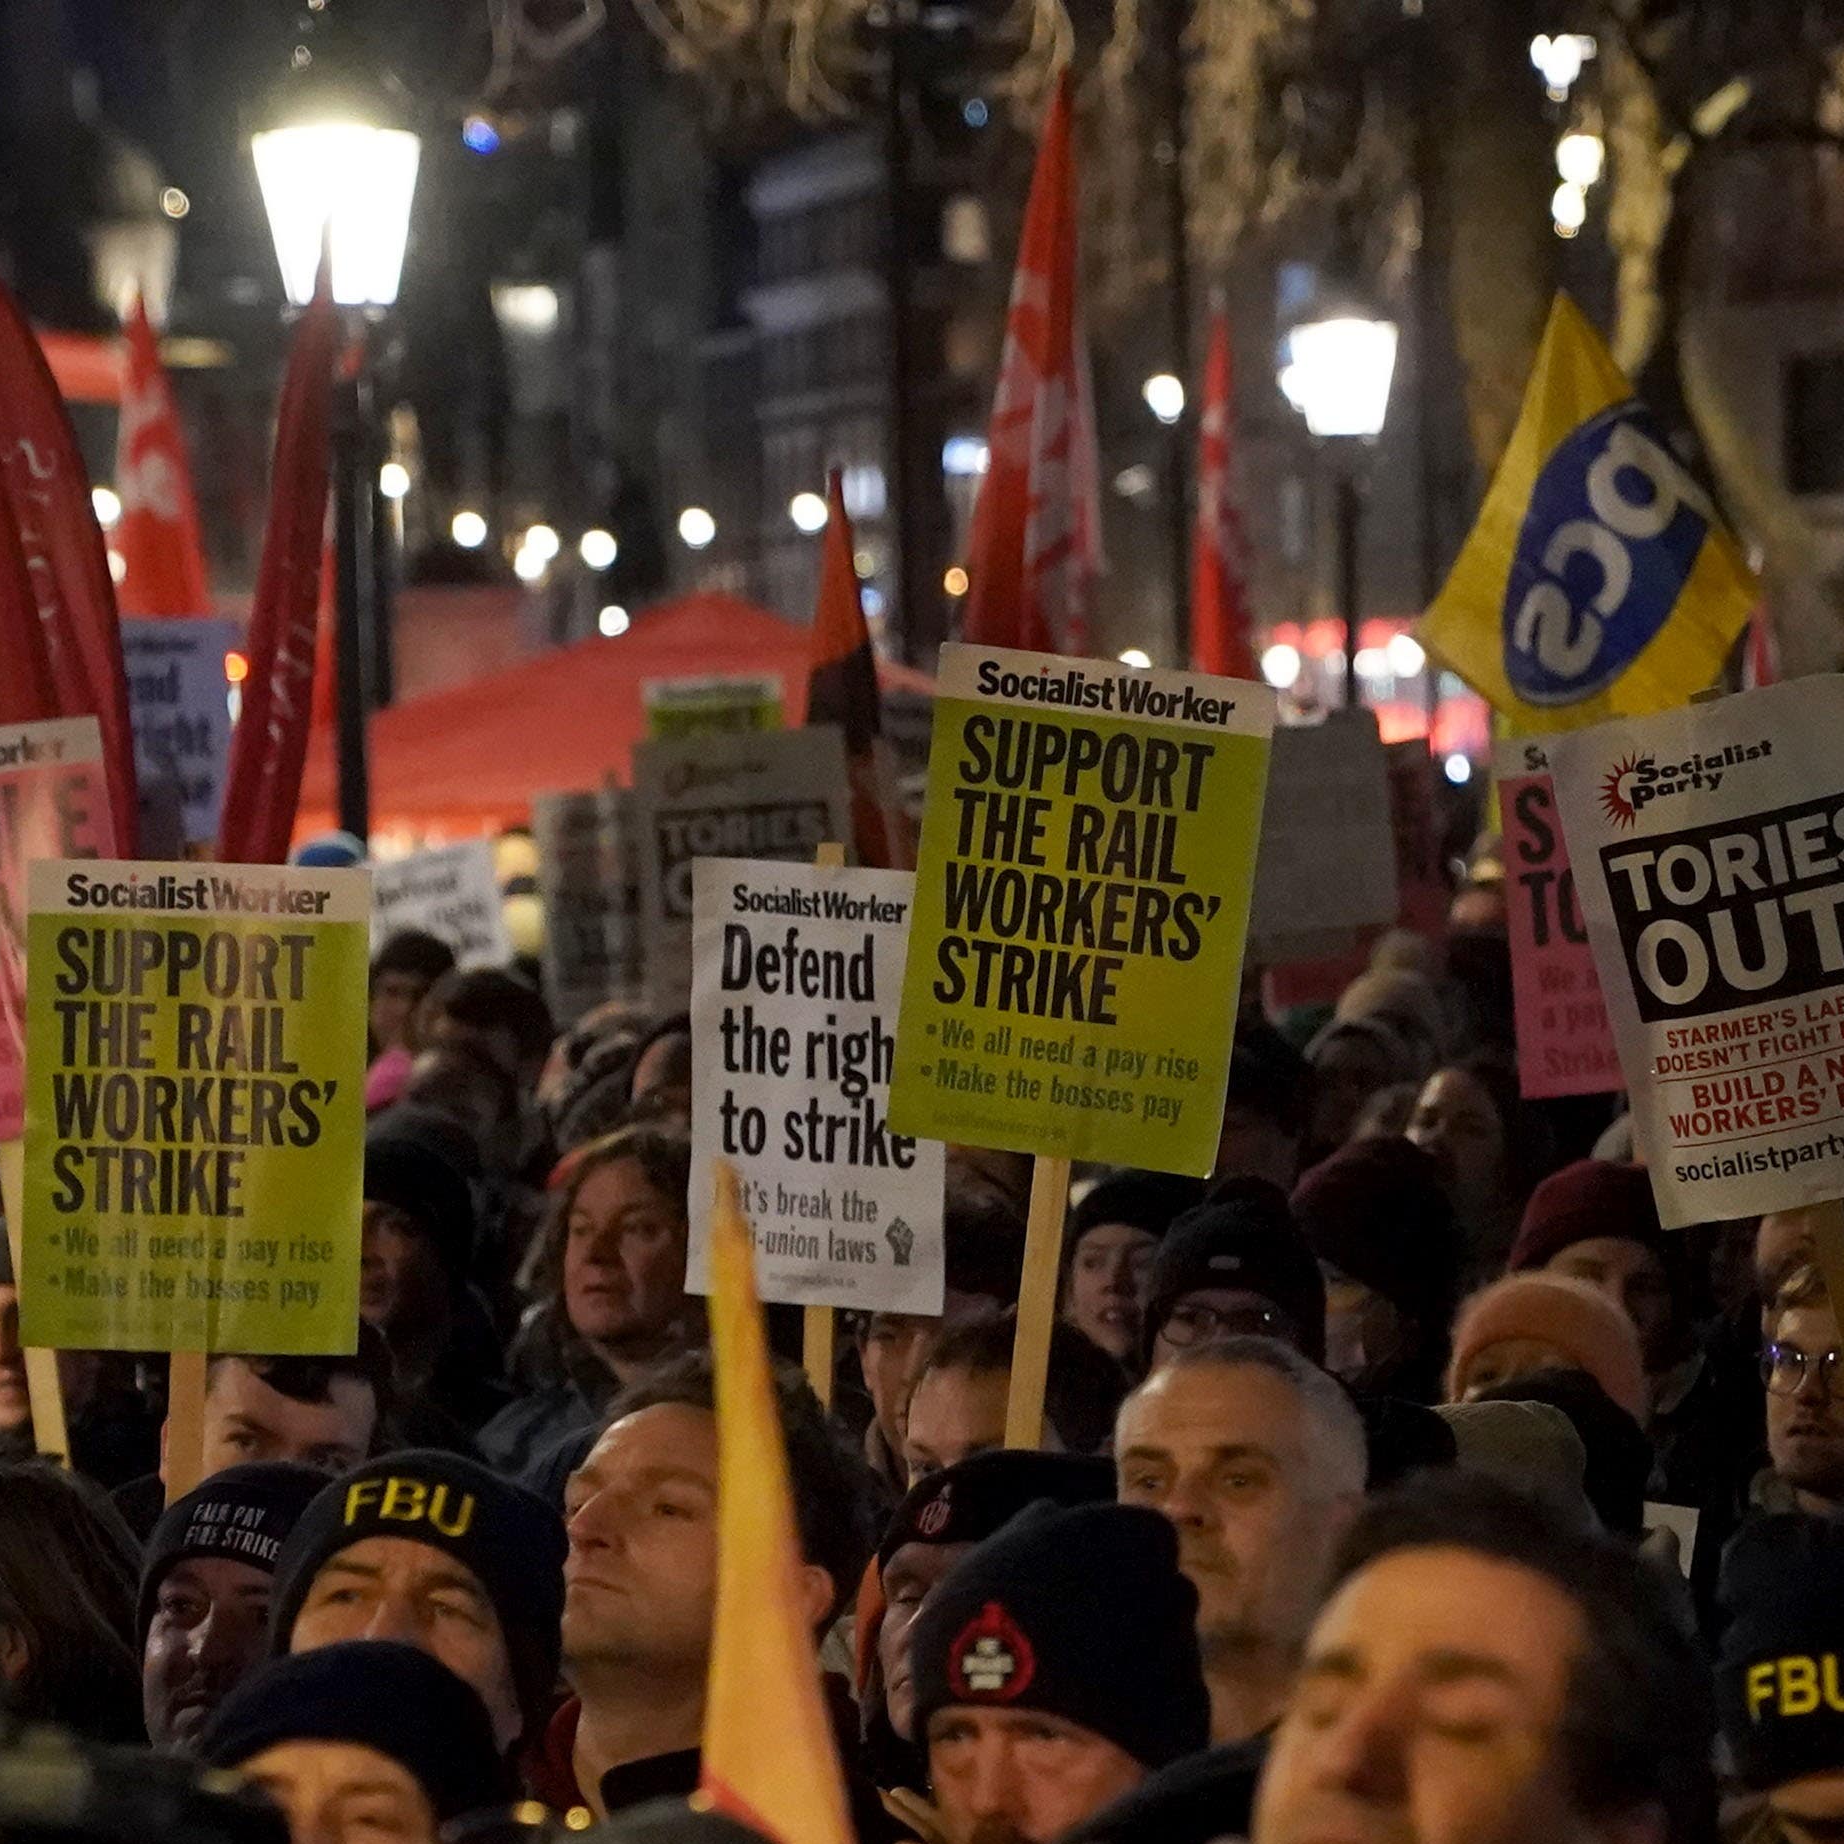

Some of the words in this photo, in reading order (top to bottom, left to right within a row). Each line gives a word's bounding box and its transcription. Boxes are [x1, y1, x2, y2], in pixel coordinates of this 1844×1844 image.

[978, 661, 1115, 712] Socialist
[1118, 677, 1235, 724] Worker
[960, 715, 1216, 812] SUPPORT
[1635, 739, 1772, 784] Socialist
[954, 788, 1052, 866] THE
[1066, 804, 1185, 885] RAIL
[67, 873, 208, 911] Socialist
[211, 877, 330, 915] Worker
[733, 884, 822, 917] Socialist
[824, 892, 907, 924] Worker
[56, 927, 315, 1001] SUPPORT
[720, 924, 874, 1002] Defend
[933, 936, 1124, 1026] STRIKE
[54, 1000, 156, 1070] THE
[177, 1004, 299, 1074] RAIL
[719, 1007, 791, 1077] the
[806, 1014, 894, 1099] righ
[940, 1018, 975, 1049] We
[984, 1023, 1011, 1057] all
[1019, 1029, 1075, 1066] need
[1084, 1043, 1097, 1066] a
[1106, 1046, 1146, 1080] pay
[1157, 1047, 1199, 1082] rise
[1656, 1044, 1751, 1075] DOESN'T
[1758, 1024, 1832, 1059] FIGHT
[1667, 1009, 1797, 1048] STARMER'S
[935, 1059, 996, 1096] Make
[1006, 1066, 1041, 1102] the
[1051, 1073, 1135, 1113] bosses
[1142, 1091, 1183, 1126] pay
[1670, 1089, 1827, 1138] WORKERS'
[1692, 1071, 1785, 1108] BUILD
[1797, 1064, 1819, 1089] A
[719, 1090, 766, 1155] to
[784, 1098, 916, 1169] strike
[53, 1147, 245, 1217] STRIKE
[777, 1182, 832, 1220] break
[842, 1188, 878, 1224] the
[65, 1228, 99, 1257] We
[111, 1229, 137, 1257] all
[149, 1230, 206, 1261] need
[239, 1237, 278, 1268] pay
[289, 1233, 334, 1263] rise
[828, 1229, 877, 1266] laws
[65, 1268, 125, 1298] Make
[139, 1269, 175, 1300] the
[187, 1271, 271, 1303] bosses
[281, 1278, 320, 1309] pay
[192, 1501, 231, 1523] FAIR
[232, 1504, 267, 1529] PAY
[344, 1476, 476, 1538] FBU
[221, 1525, 281, 1562] STRIKE
